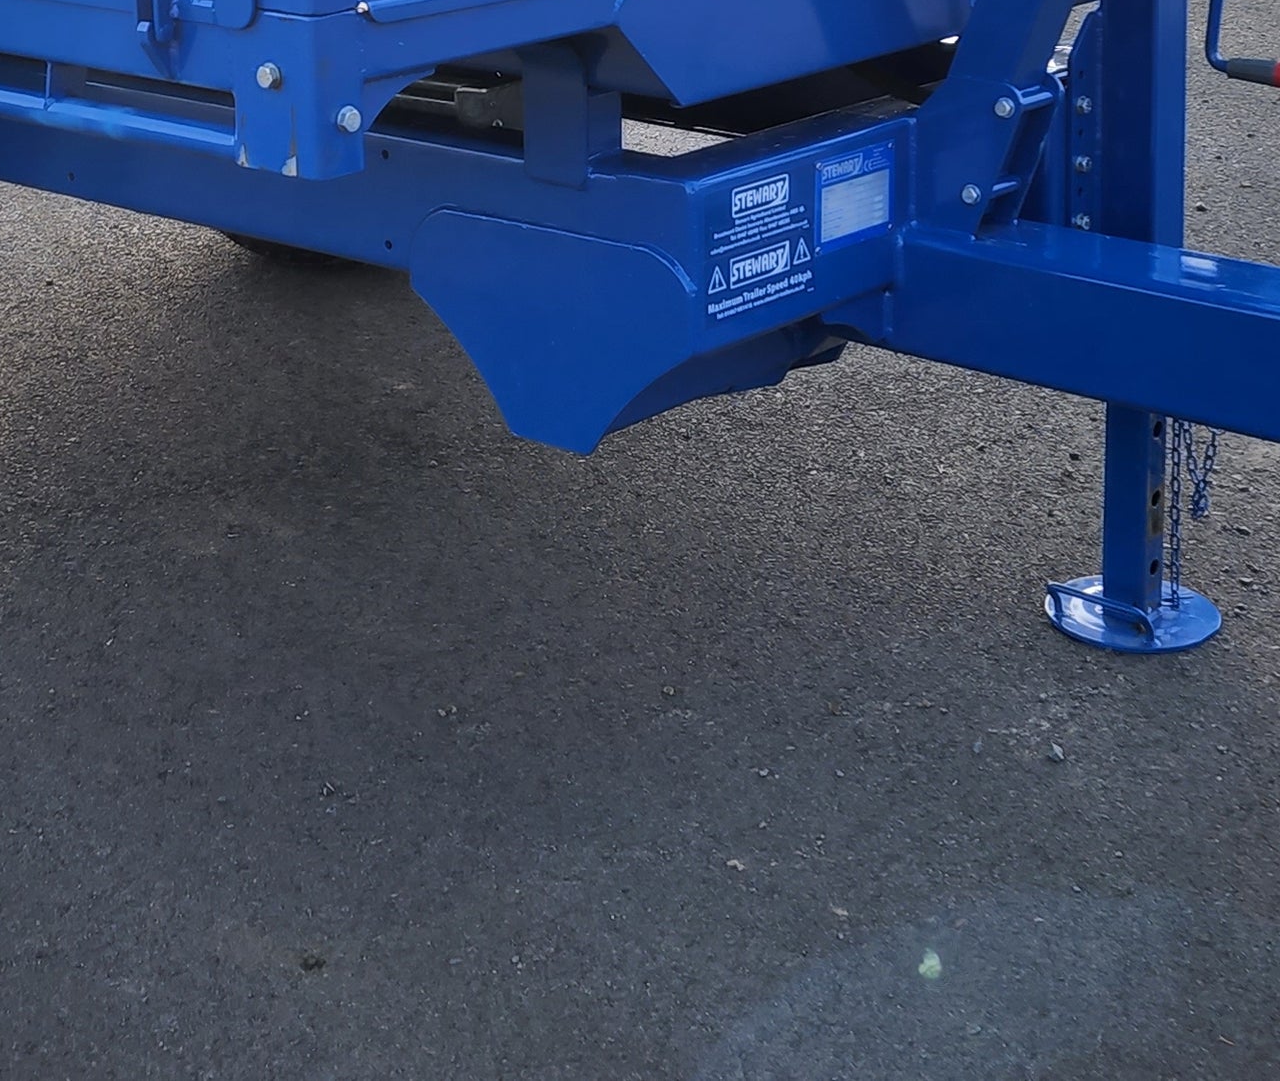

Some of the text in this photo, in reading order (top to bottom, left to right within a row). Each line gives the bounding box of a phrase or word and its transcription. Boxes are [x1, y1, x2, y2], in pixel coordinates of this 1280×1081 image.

[823, 157, 861, 180] STEWART
[734, 178, 787, 211] STEWART
[732, 245, 788, 282] STEWART
[708, 295, 743, 314] Maximum
[743, 286, 766, 302] Trailer
[767, 277, 789, 294] Speed
